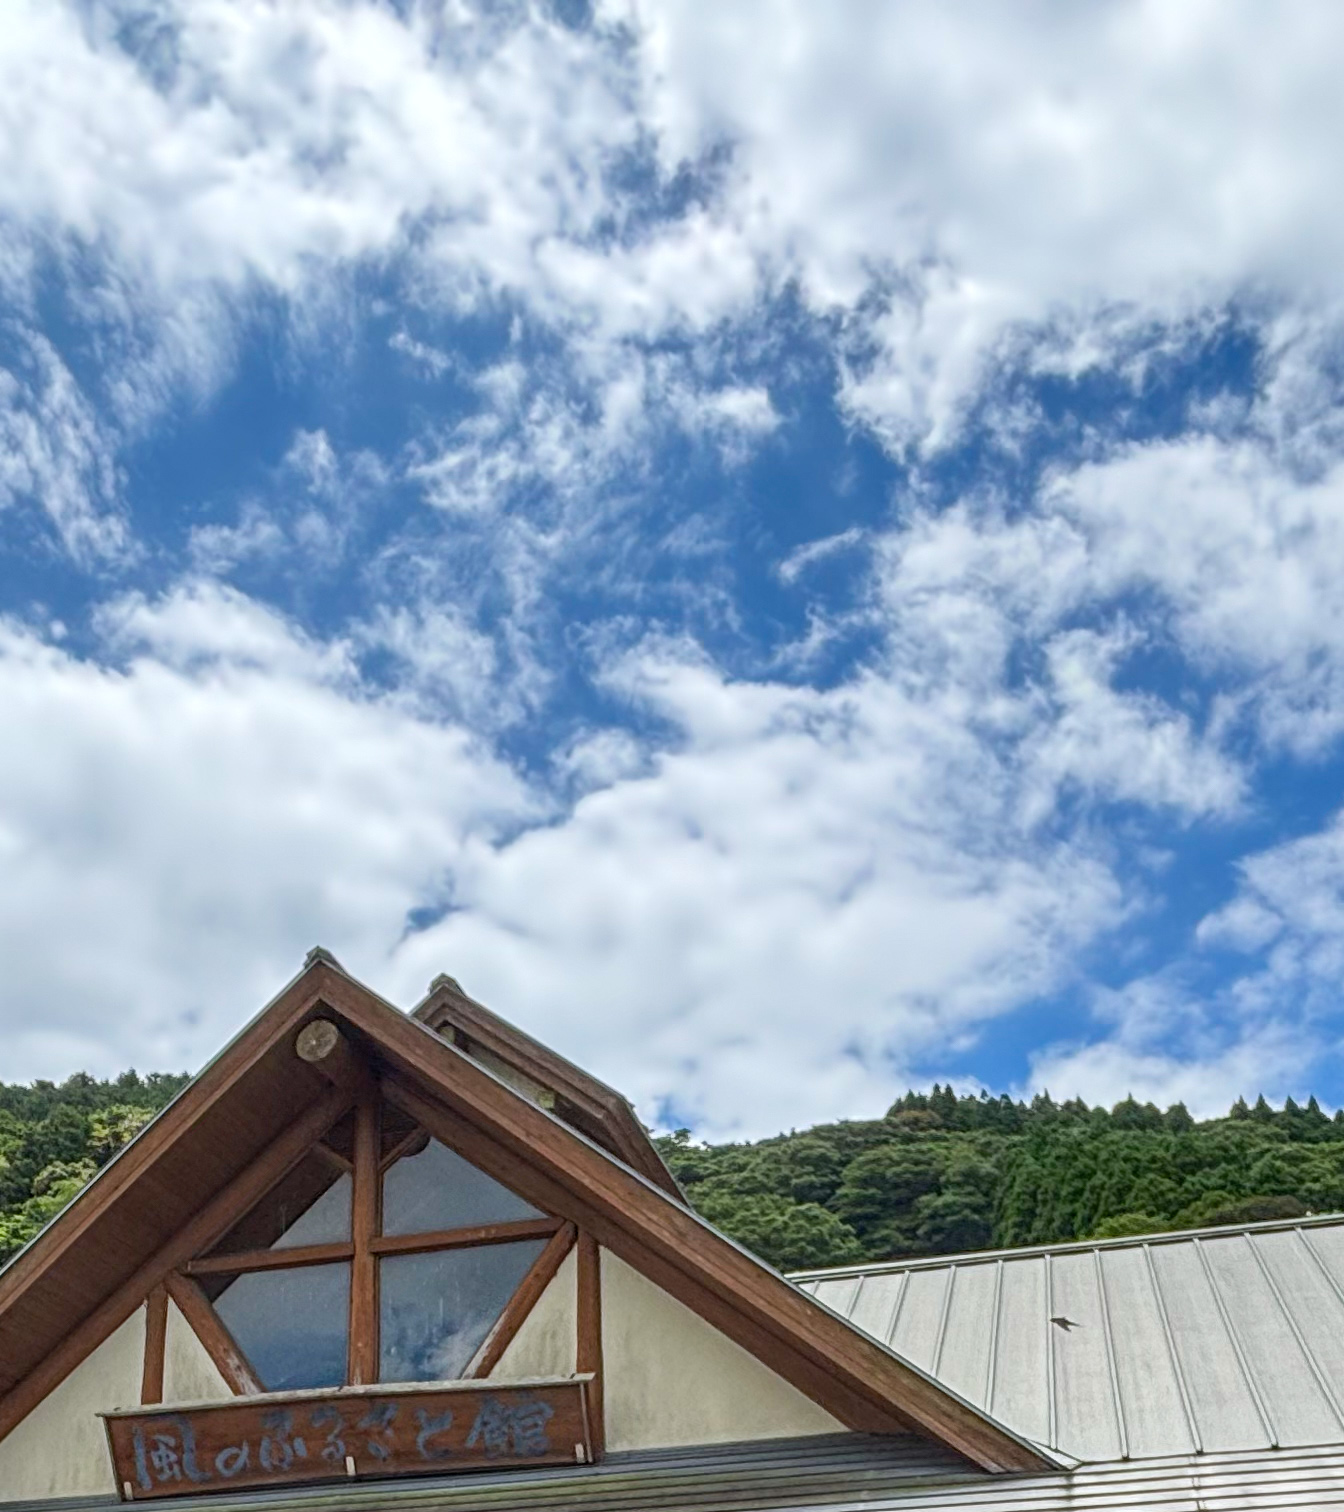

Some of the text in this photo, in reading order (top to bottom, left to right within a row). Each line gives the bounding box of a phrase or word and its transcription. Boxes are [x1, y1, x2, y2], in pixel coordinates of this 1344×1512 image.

[131, 1394, 554, 1490] 風のふるさと館
